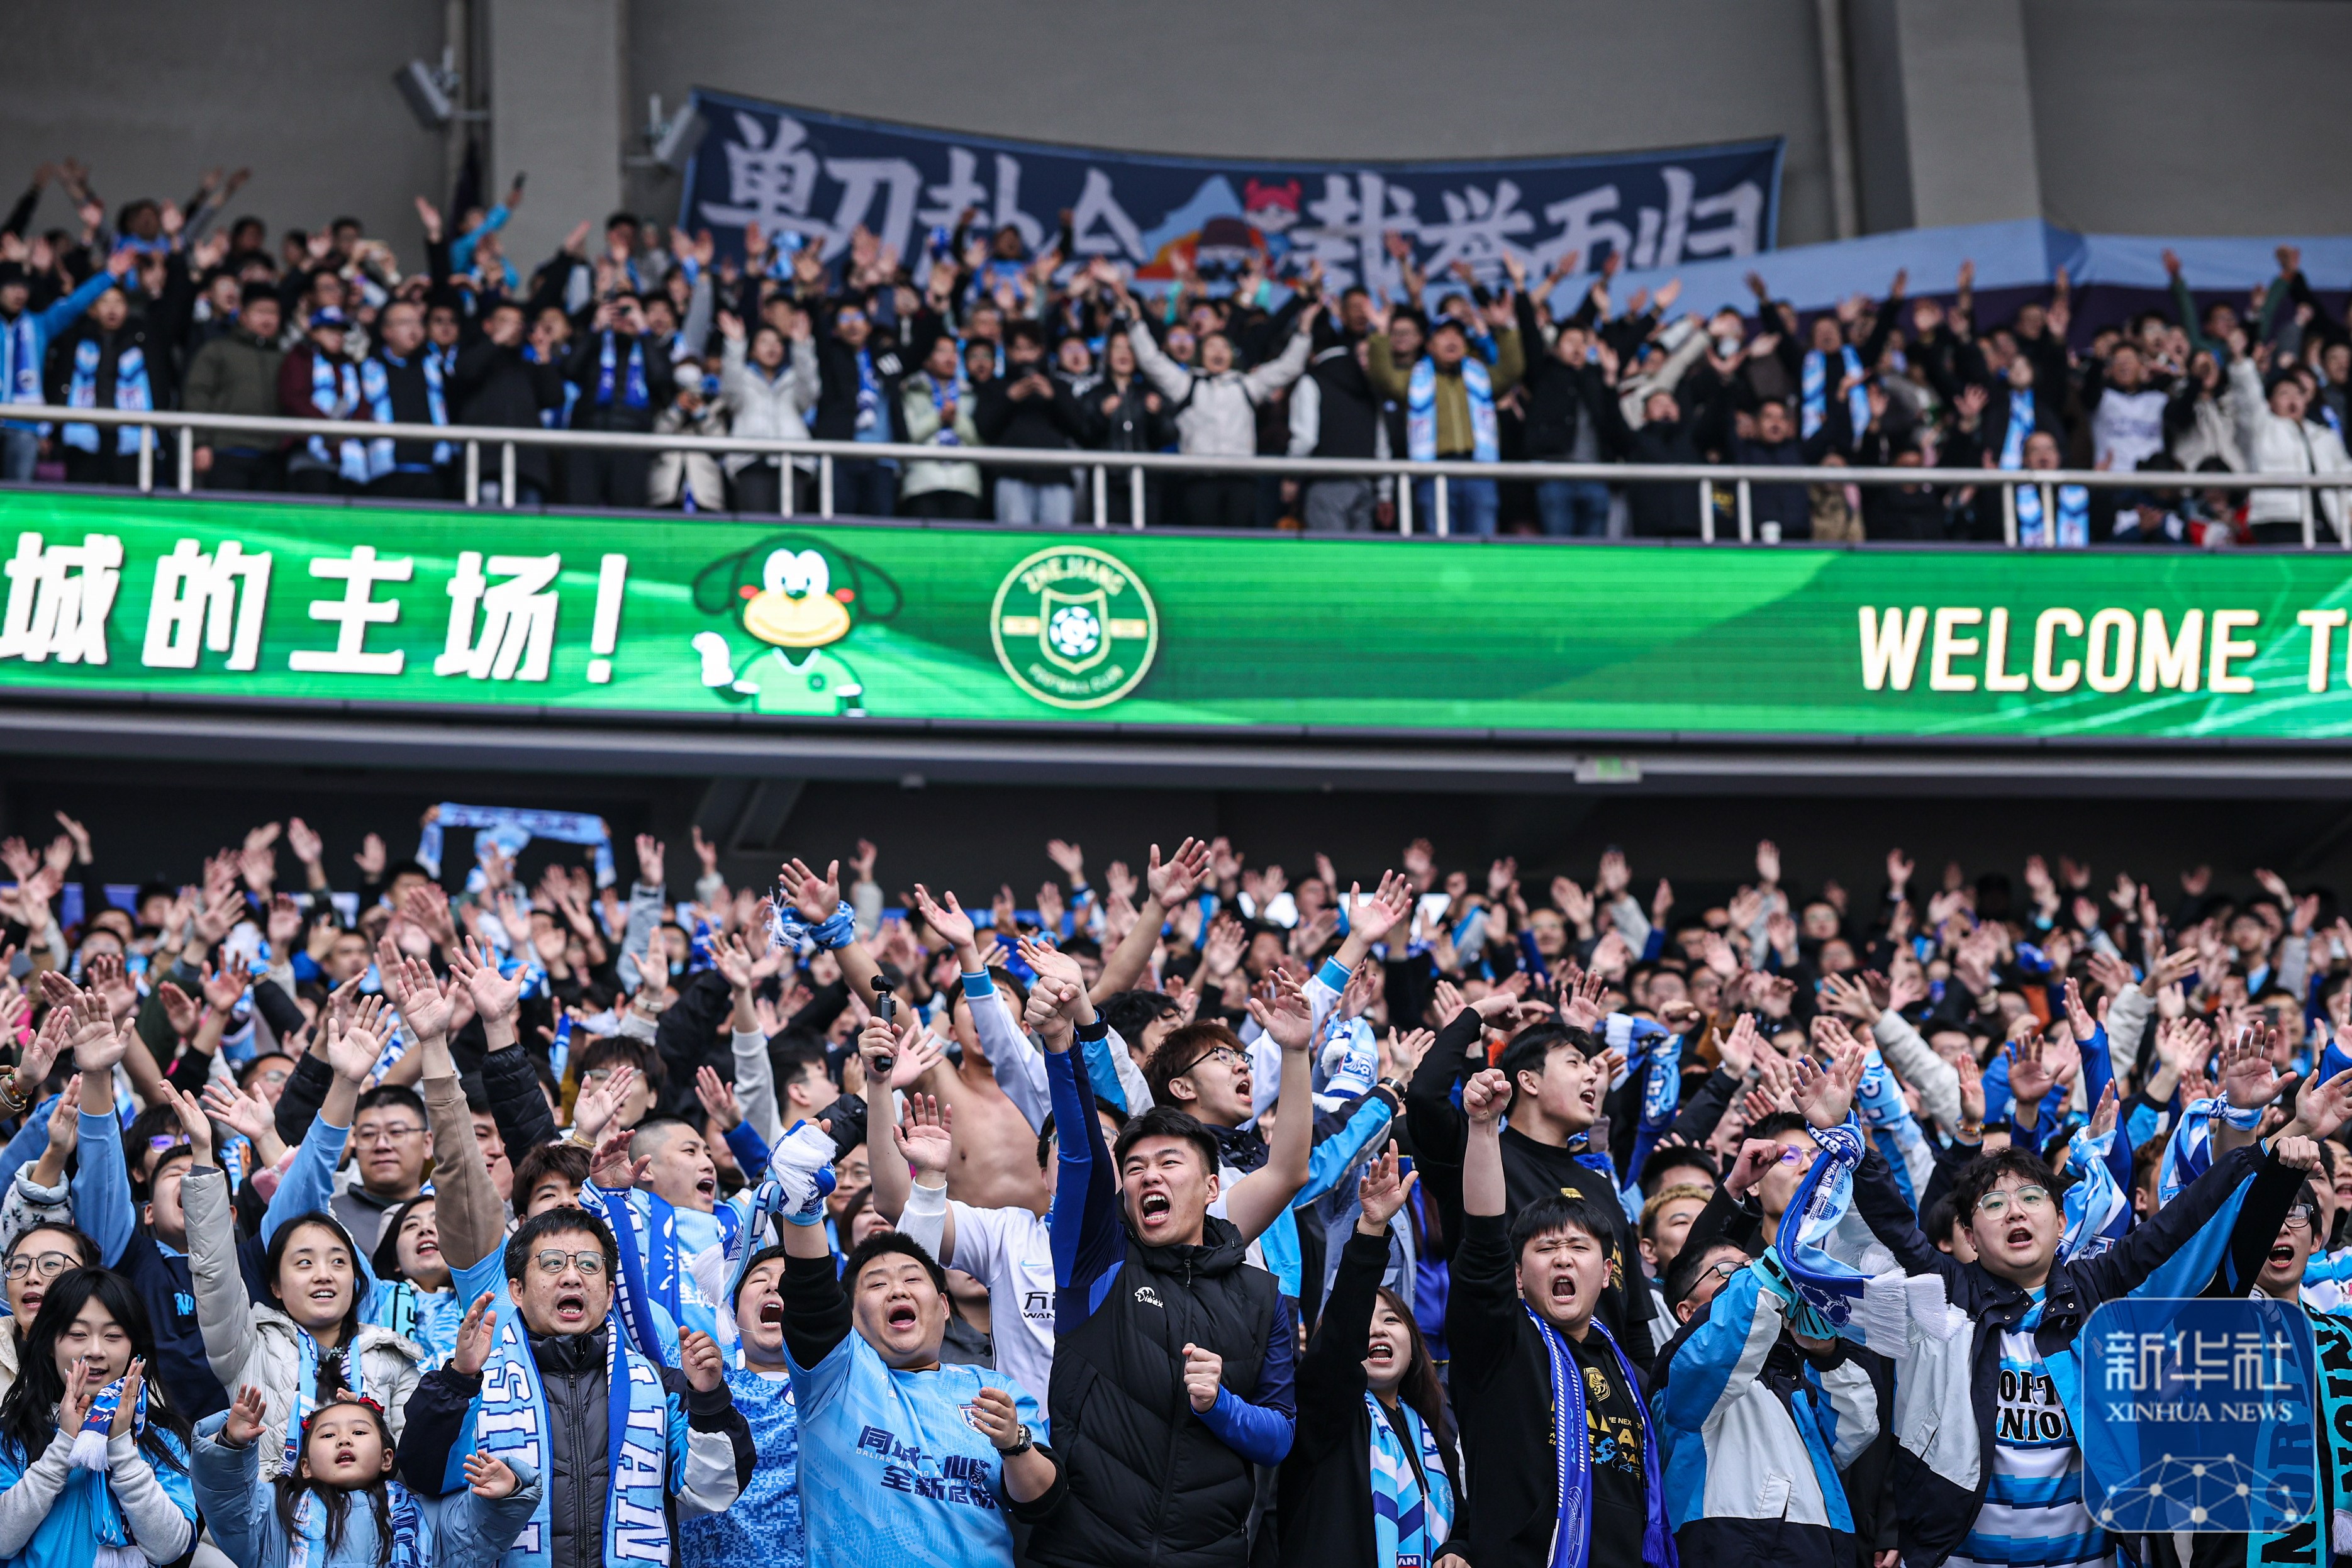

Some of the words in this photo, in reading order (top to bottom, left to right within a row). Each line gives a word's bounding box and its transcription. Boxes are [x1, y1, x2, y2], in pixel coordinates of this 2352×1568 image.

[1858, 606, 2260, 693] WELCOME
[2297, 608, 2352, 693] T
[856, 1448, 892, 1464] DALIAN
